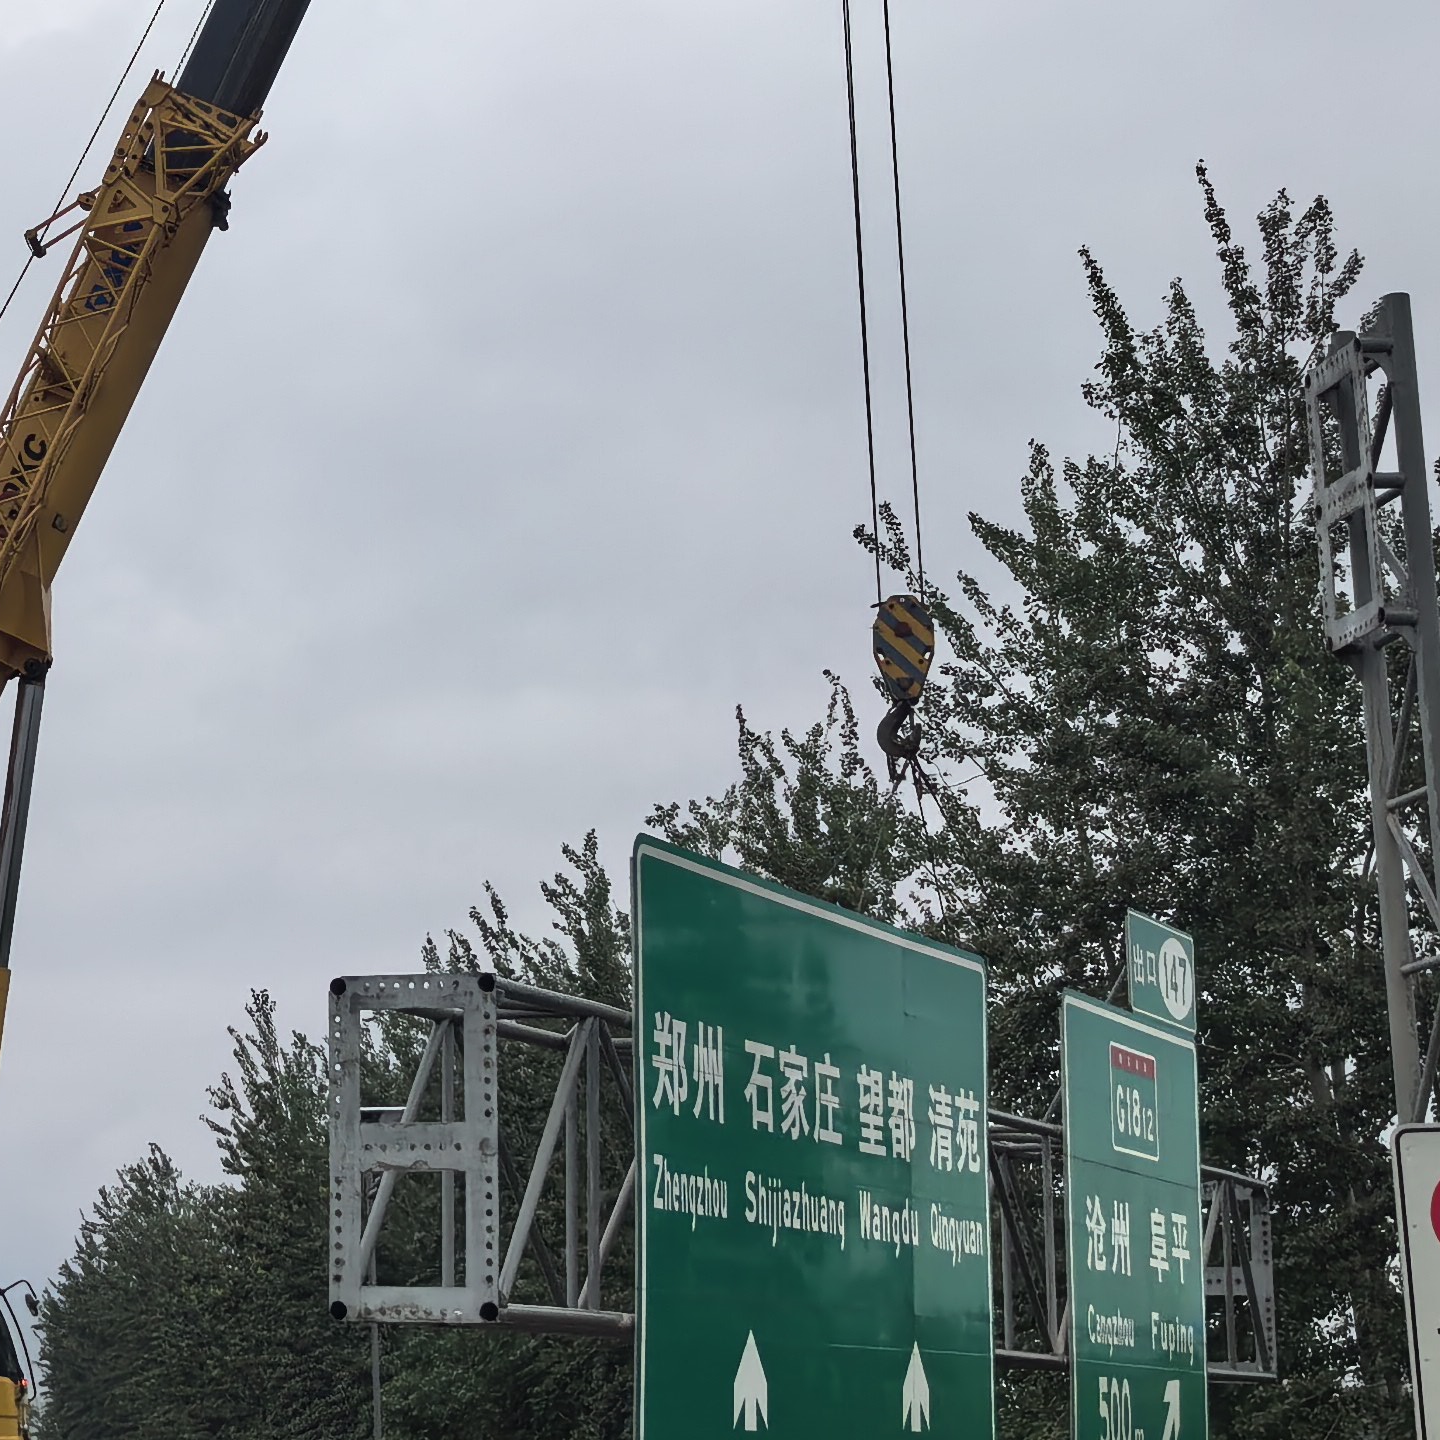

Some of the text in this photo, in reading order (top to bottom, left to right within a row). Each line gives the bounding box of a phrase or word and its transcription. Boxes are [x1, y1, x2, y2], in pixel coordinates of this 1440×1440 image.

[1132, 944, 1187, 1006] 出口 147
[651, 1011, 981, 1173] 郑州 石家庄 望都 清苑
[1116, 1084, 1155, 1142] G1812
[653, 1153, 984, 1268] Zhengzhou Shijiazhuang Wangdu Qingyuan
[1085, 1194, 1191, 1285] 沧州 阜平
[1087, 1304, 1195, 1367] Cangzhou Fuping
